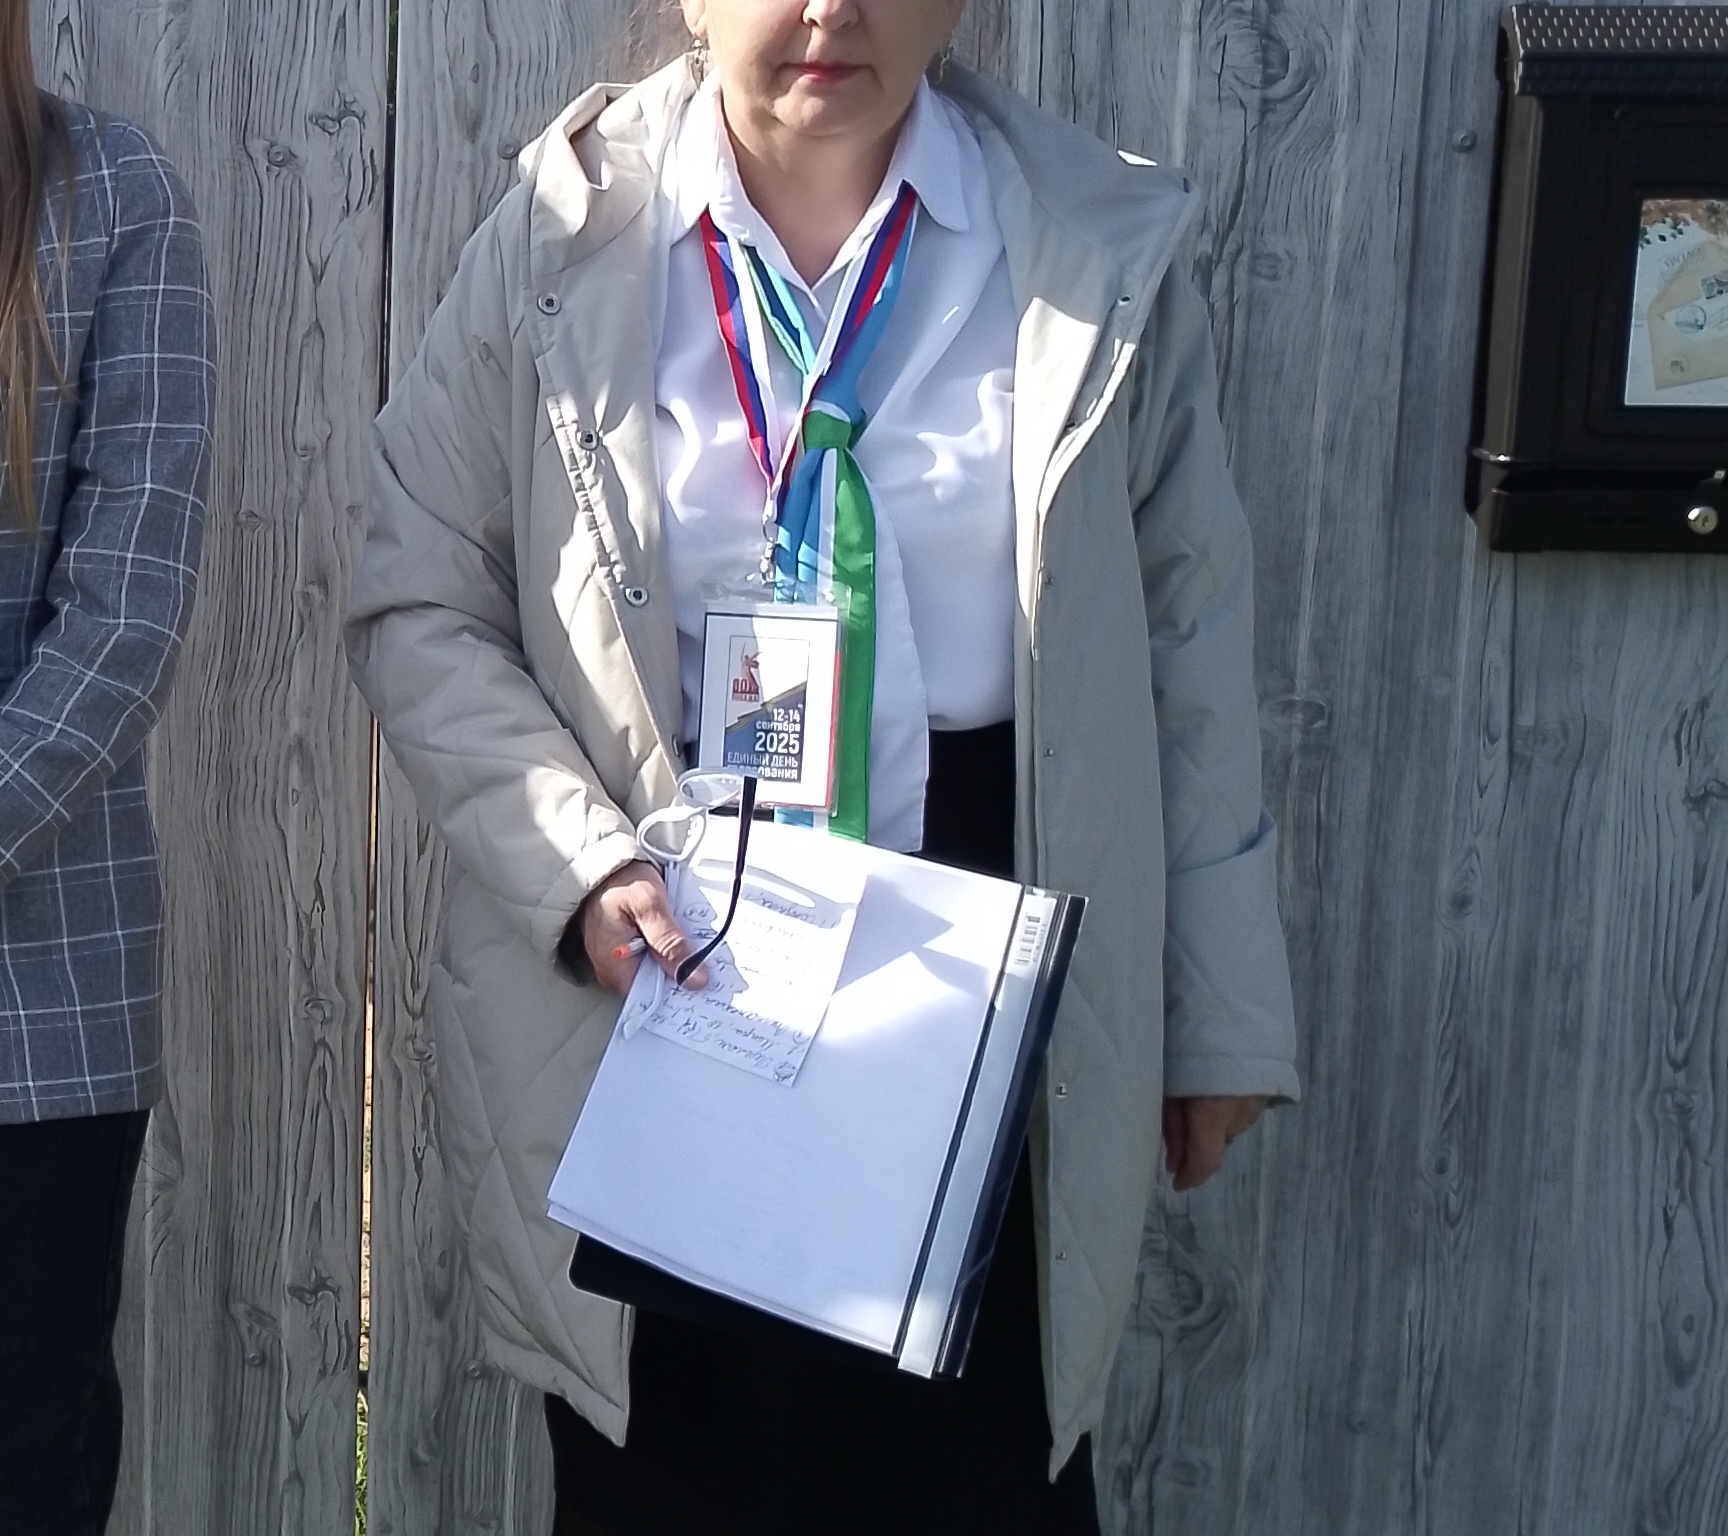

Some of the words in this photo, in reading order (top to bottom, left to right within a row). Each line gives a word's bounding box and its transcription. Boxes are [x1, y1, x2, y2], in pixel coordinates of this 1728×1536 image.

[773, 708, 800, 722] 12-14
[755, 720, 801, 733] сентября
[754, 731, 800, 754] 2025
[771, 754, 798, 768] ДЕНЬ
